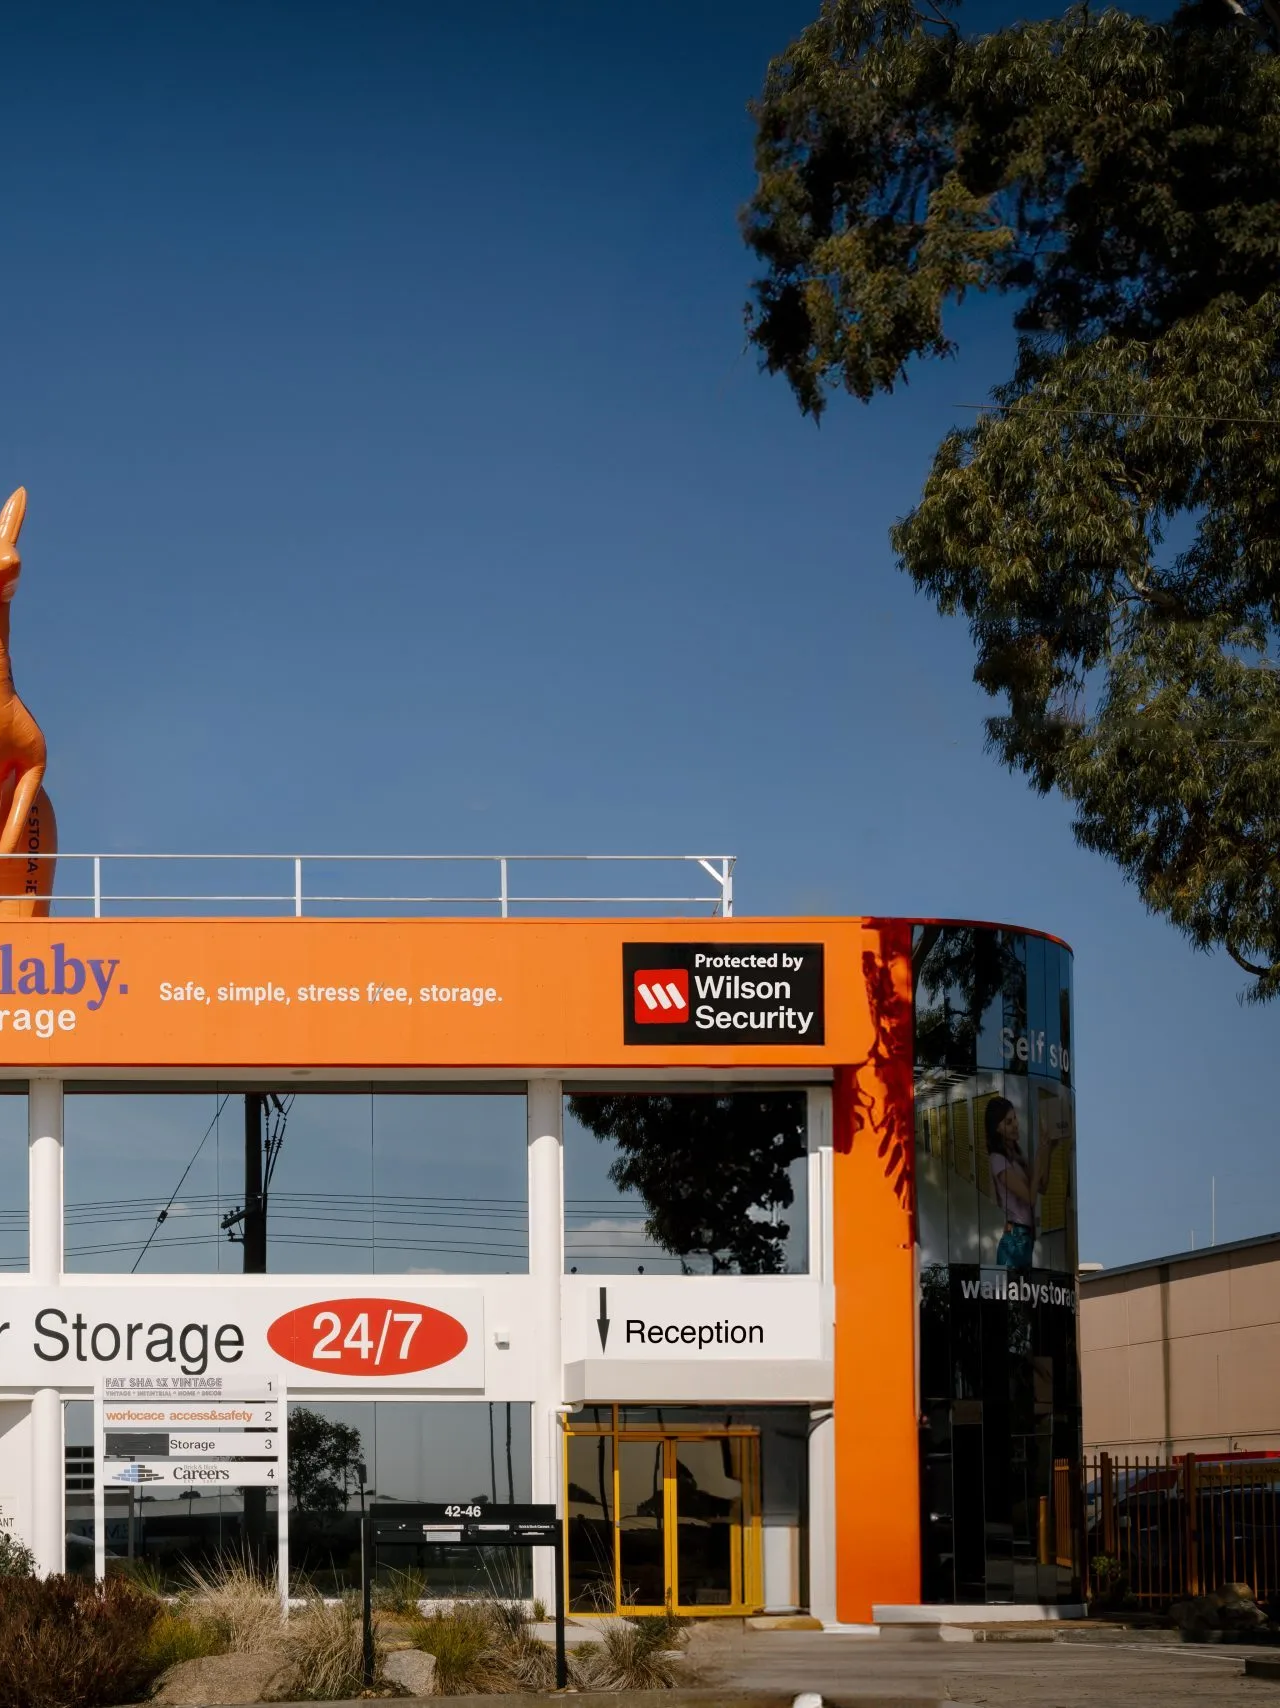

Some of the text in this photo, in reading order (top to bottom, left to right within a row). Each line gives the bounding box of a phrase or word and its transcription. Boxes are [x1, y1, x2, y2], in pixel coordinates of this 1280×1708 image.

[695, 953, 804, 972] Protected by
[160, 982, 502, 1006] Safe, simple, stress free, storage.
[695, 976, 790, 999] Wilson
[696, 1005, 813, 1034] Security
[998, 1027, 1045, 1063] Self
[34, 1309, 244, 1375] Storage
[313, 1310, 422, 1365] 24/7
[627, 1320, 763, 1349] Reception
[171, 1377, 222, 1388] VINTAGE
[266, 1380, 274, 1392] 1
[264, 1411, 272, 1422] 2
[170, 1439, 273, 1450] Storage 3
[173, 1466, 275, 1480] Careers 4
[445, 1506, 481, 1517] 42-46
